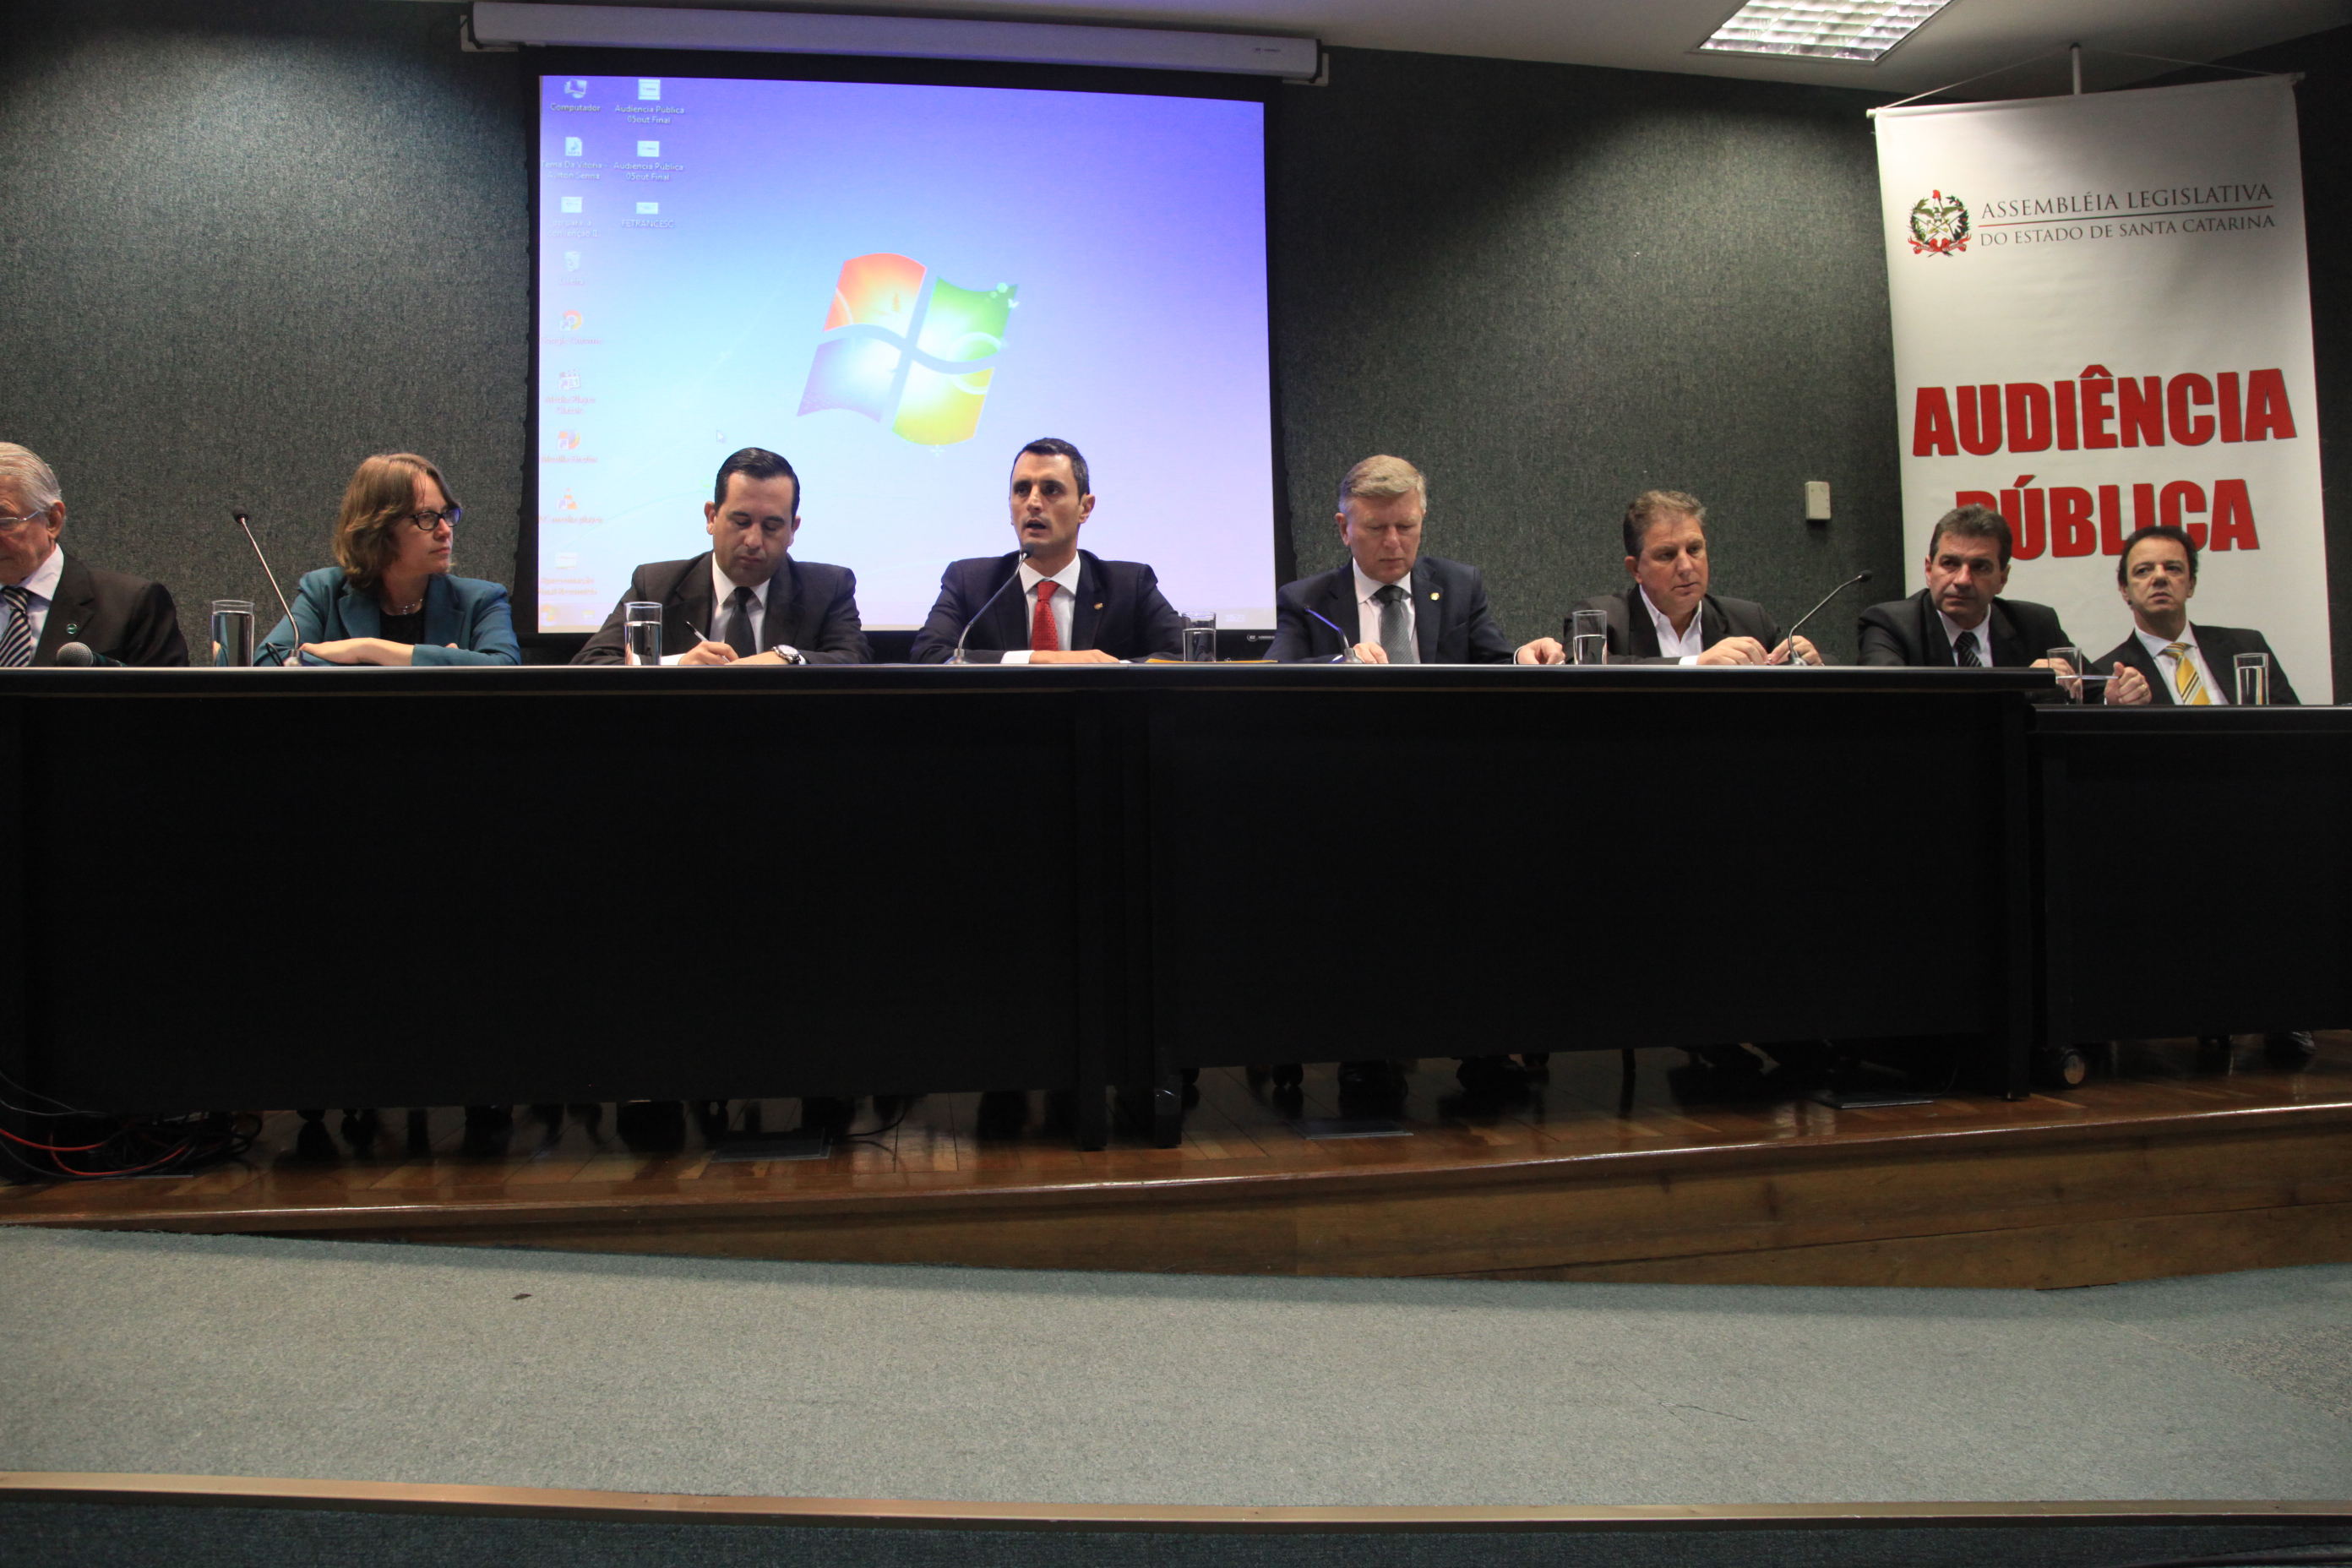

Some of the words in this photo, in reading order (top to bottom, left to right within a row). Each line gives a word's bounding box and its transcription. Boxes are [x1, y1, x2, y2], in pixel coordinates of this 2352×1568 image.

[550, 102, 601, 113] Computador
[651, 115, 671, 124] Final
[564, 160, 575, 168] Da
[575, 171, 601, 179] Senna
[651, 172, 670, 181] Final
[1980, 191, 2119, 220] ASSEMBLÉIA
[2127, 183, 2273, 210] LEGISLATIVA
[621, 219, 674, 228] FETRANCESC
[1980, 232, 2007, 247] DO
[2015, 226, 2083, 244] ESTADO
[2090, 225, 2114, 239] DE
[2120, 220, 2176, 237] SANTA
[2182, 215, 2276, 233] CATARINA
[1913, 364, 2297, 457] AUDIÊNCIA
[1955, 474, 2261, 560] ÚBLICA
